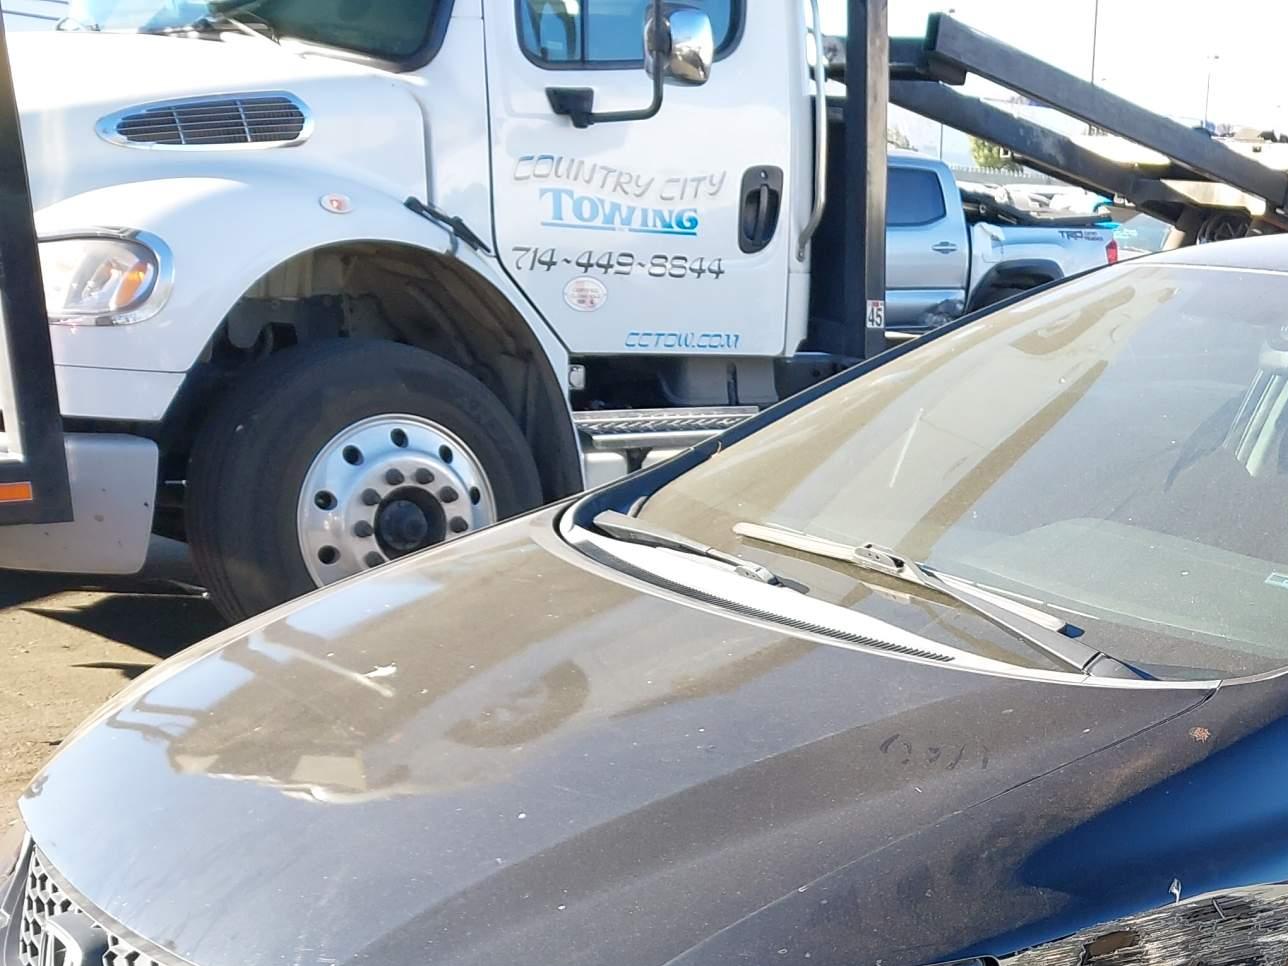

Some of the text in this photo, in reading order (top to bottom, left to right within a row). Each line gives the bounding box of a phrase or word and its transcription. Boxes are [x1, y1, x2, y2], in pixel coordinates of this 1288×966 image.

[513, 154, 727, 201] COUNTRY CITY
[539, 186, 699, 230] TOWING
[868, 306, 882, 327] 45
